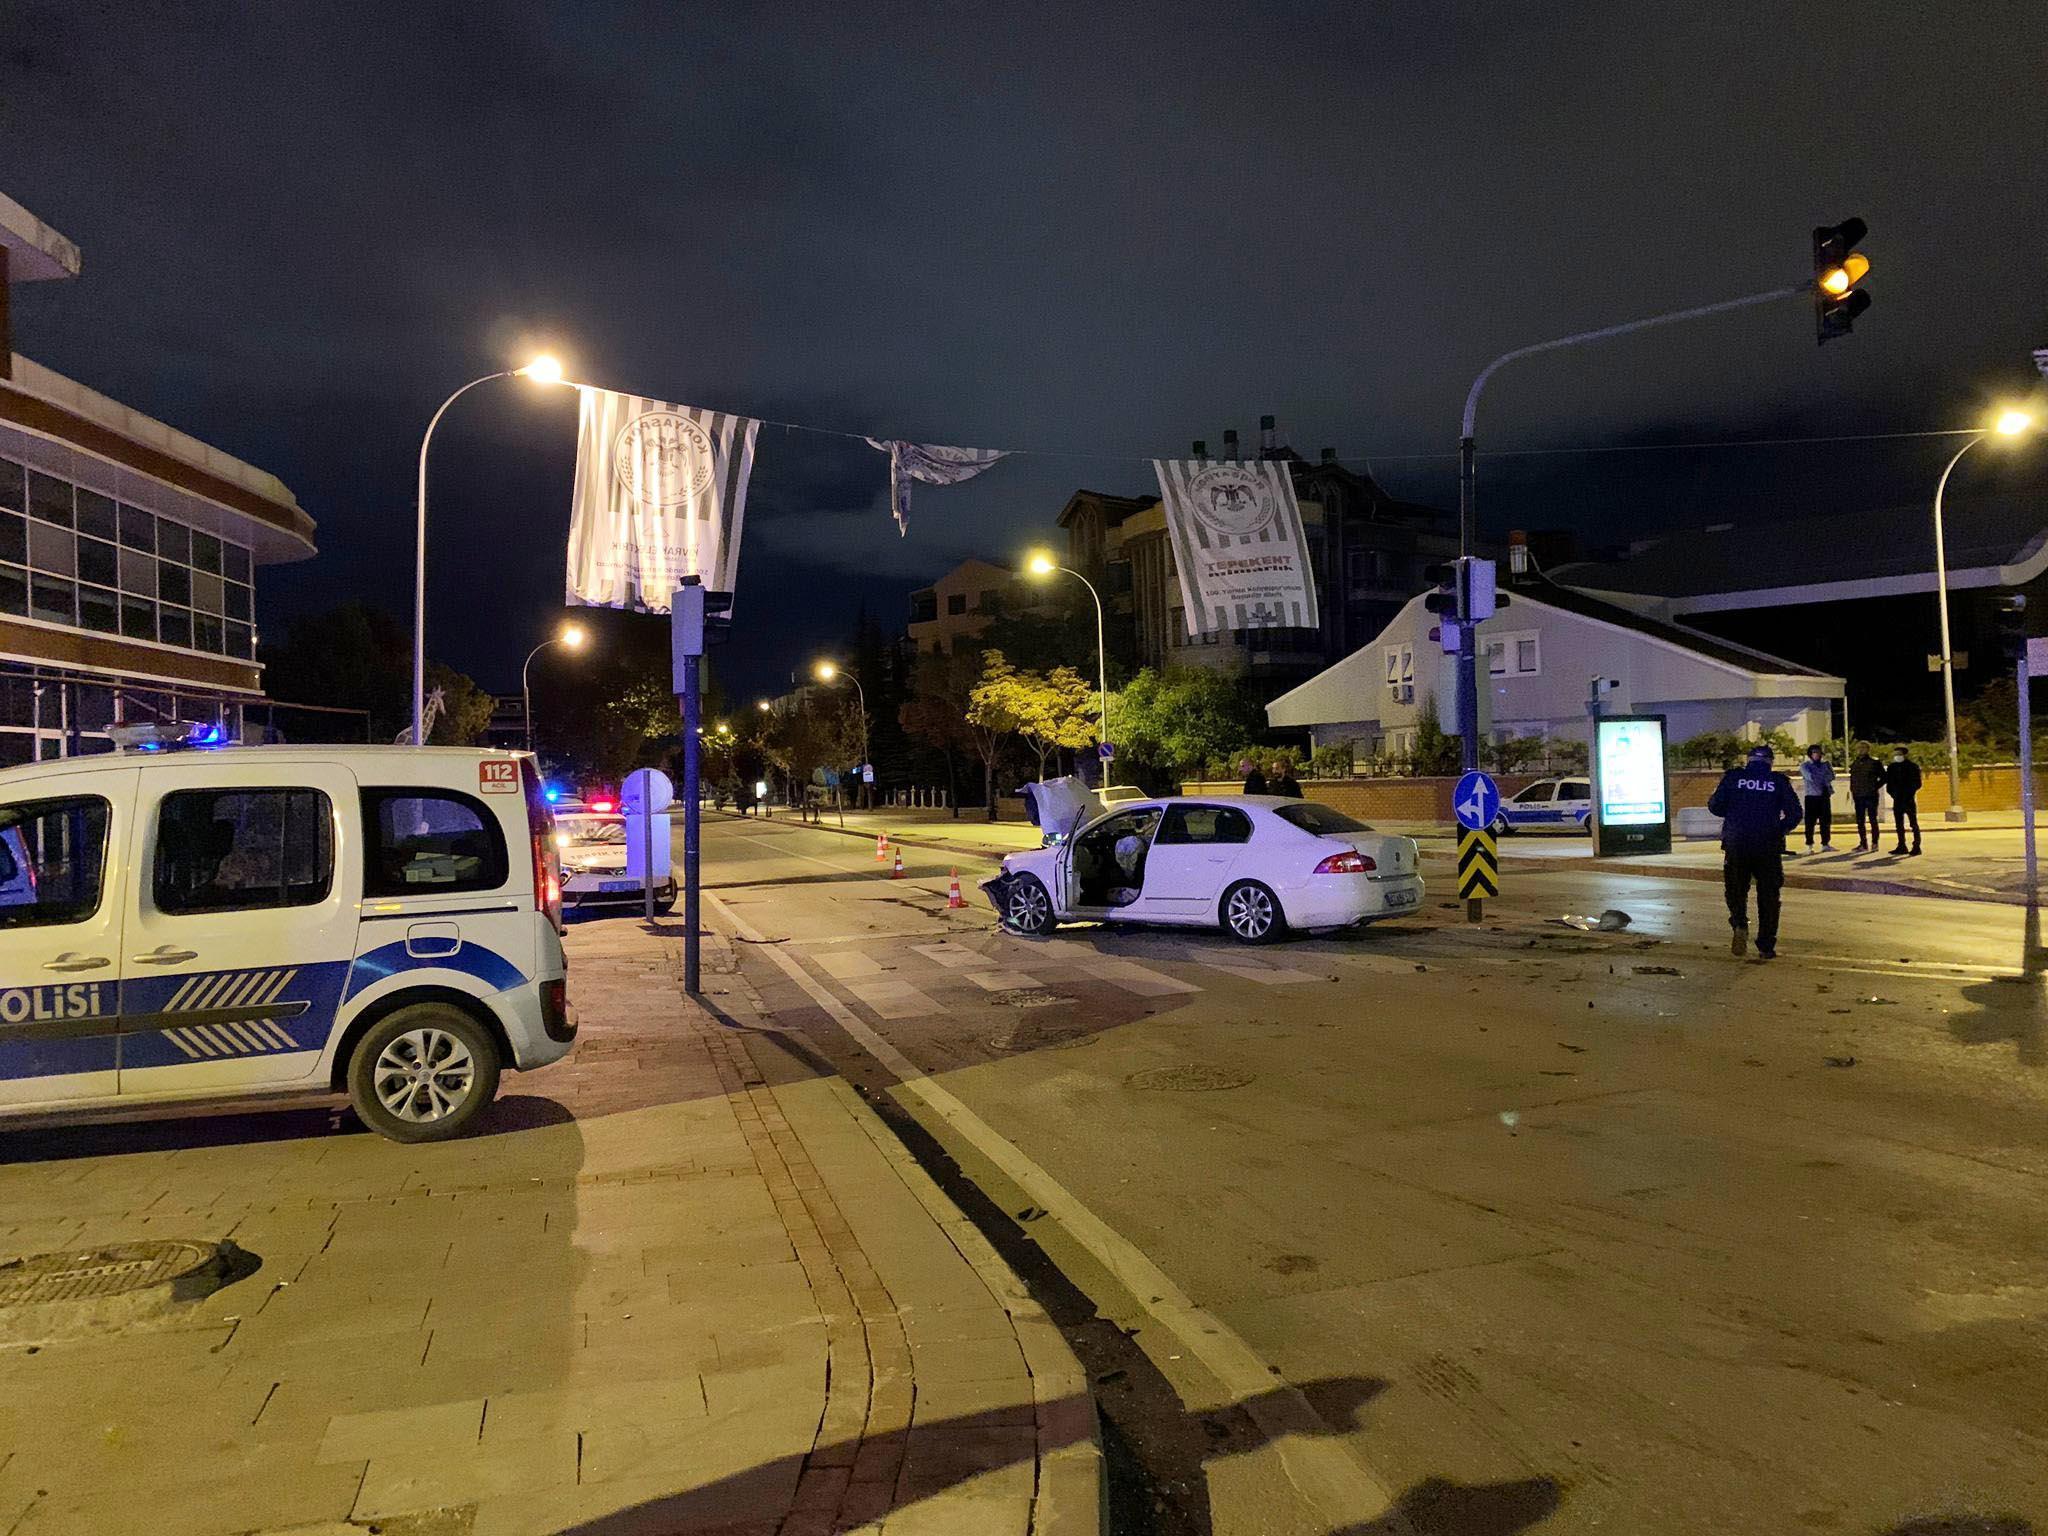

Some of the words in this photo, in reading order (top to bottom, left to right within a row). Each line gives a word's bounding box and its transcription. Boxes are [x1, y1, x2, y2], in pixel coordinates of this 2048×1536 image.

[1205, 555, 1292, 572] TEPEKENT
[485, 764, 513, 780] 112
[1738, 779, 1776, 792] POLİS
